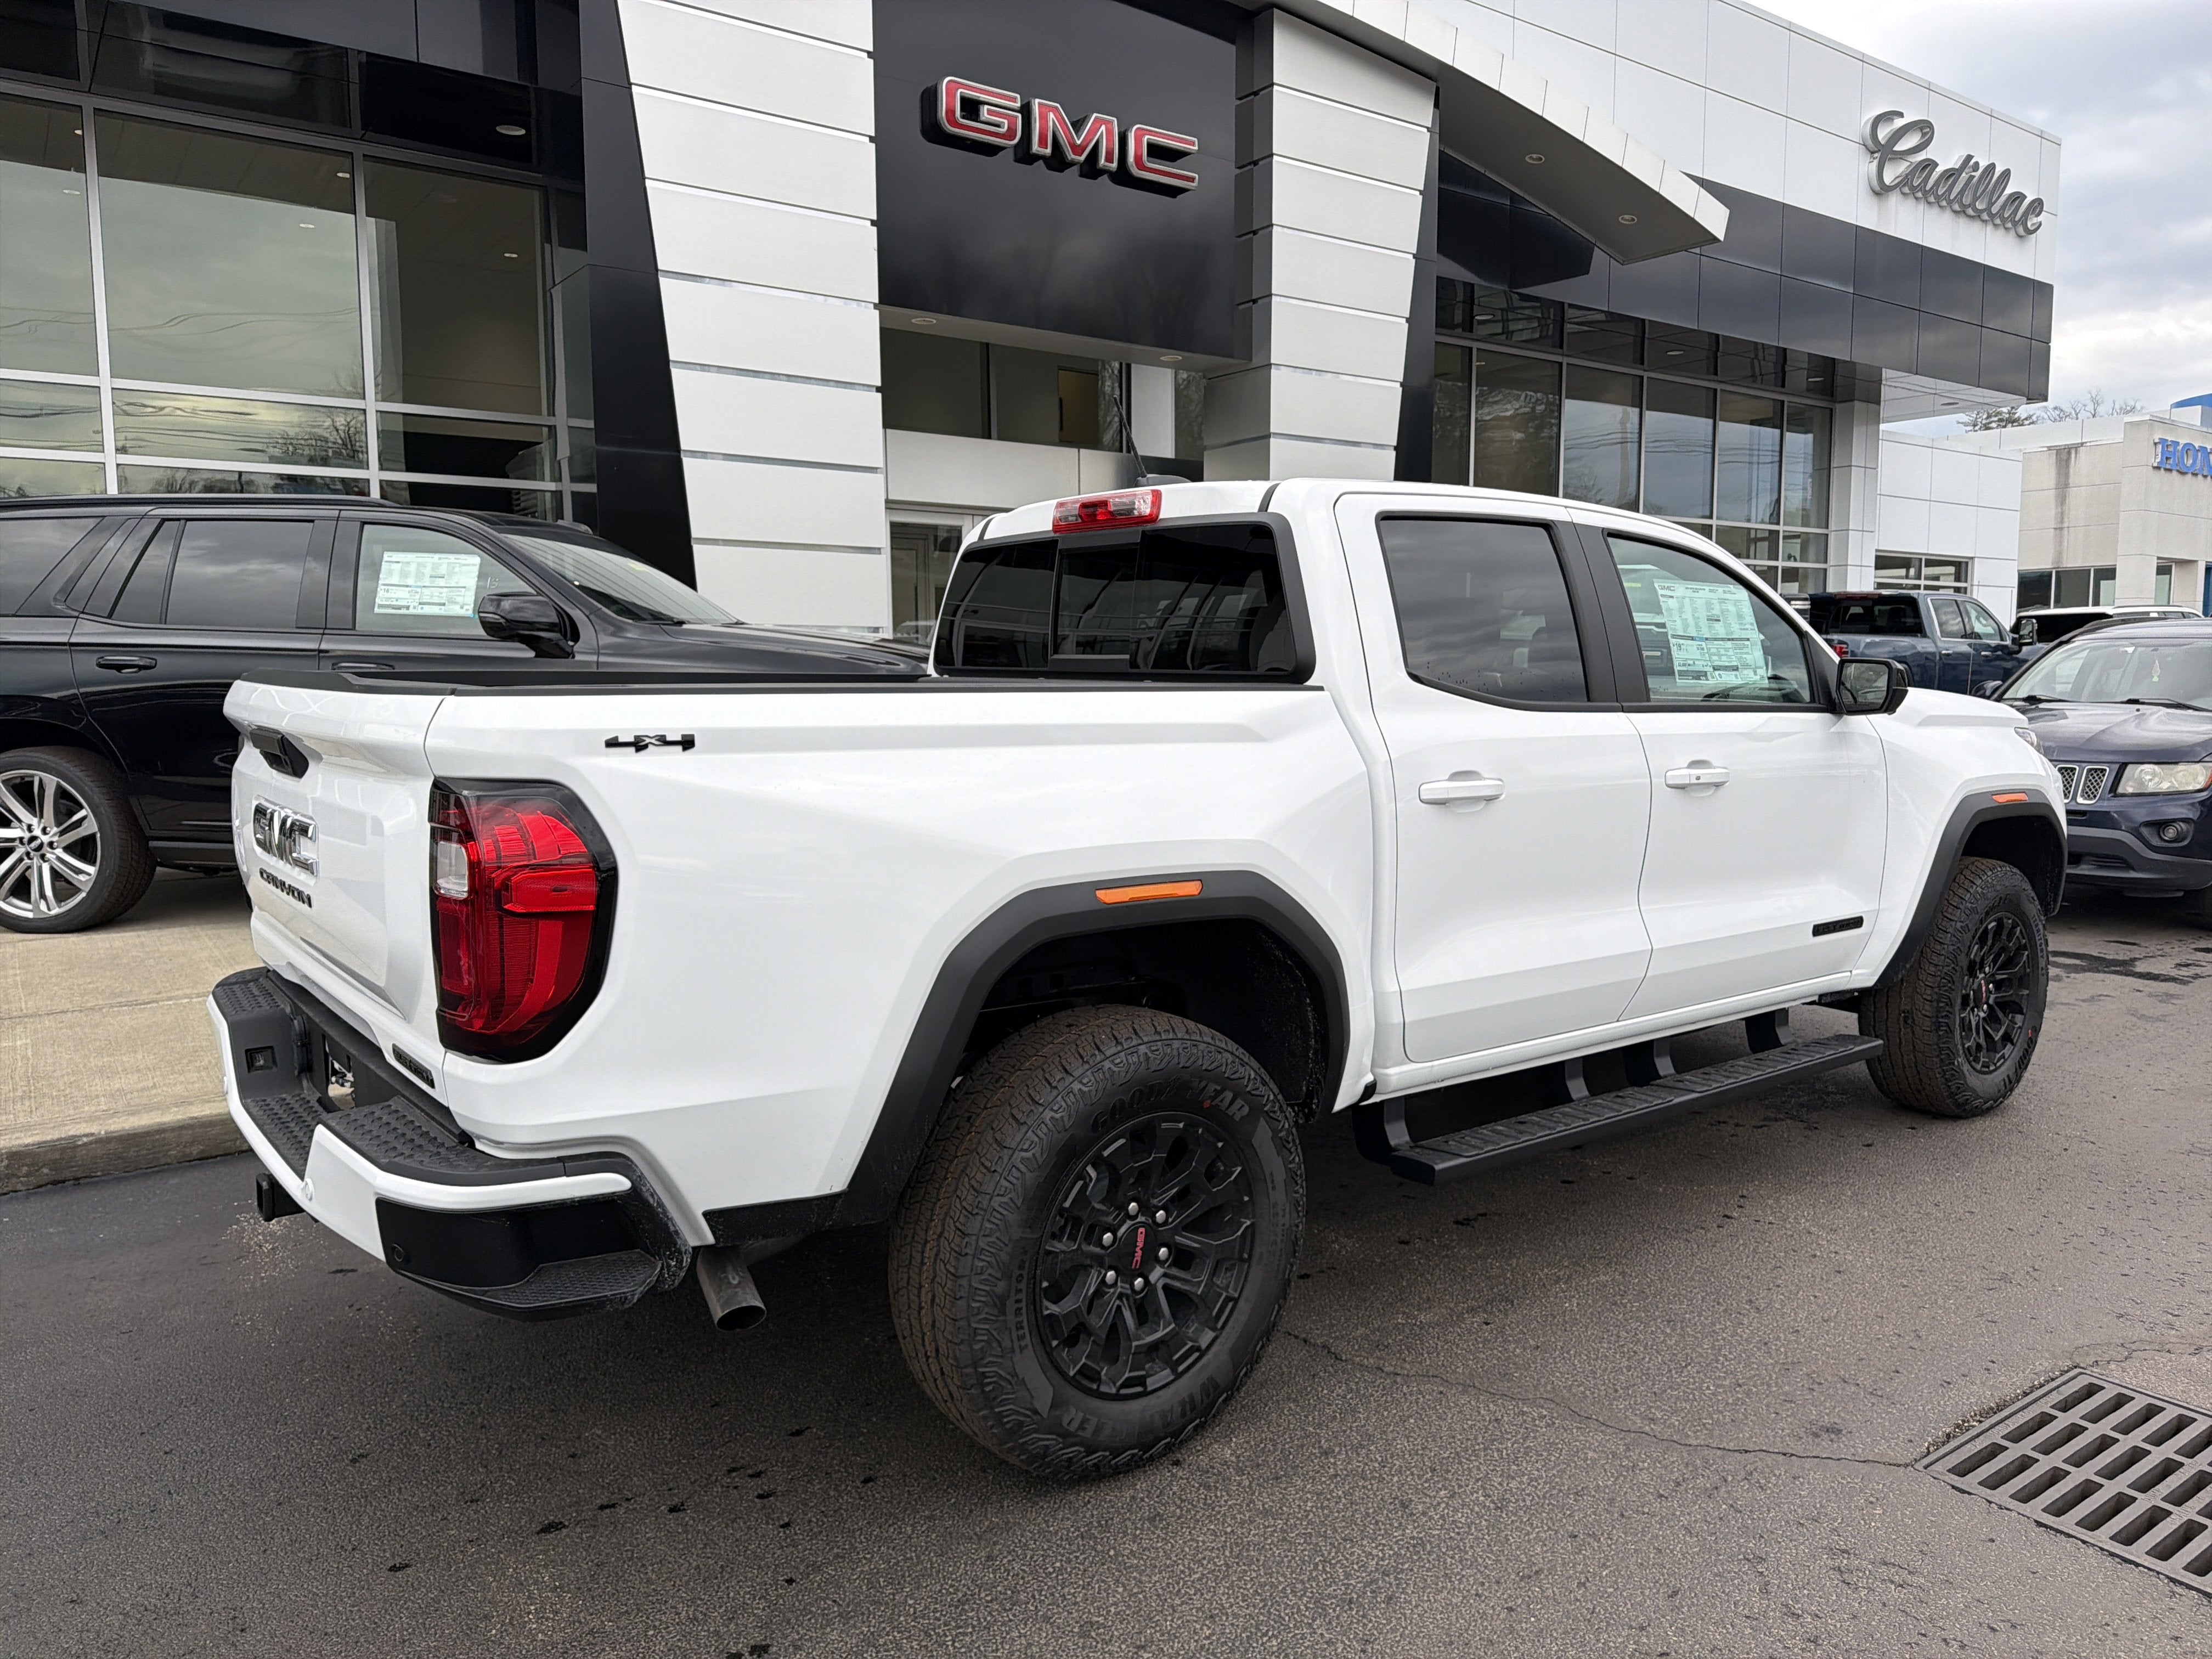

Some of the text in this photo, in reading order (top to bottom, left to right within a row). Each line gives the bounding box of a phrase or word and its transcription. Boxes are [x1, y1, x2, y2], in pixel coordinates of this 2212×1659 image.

[936, 76, 1199, 190] GMC
[1865, 110, 2045, 236] Cadillac
[1675, 642, 1682, 651] 19
[253, 802, 319, 877] GMC
[259, 867, 312, 909] CANYON
[1132, 1227, 1146, 1269] GMC
